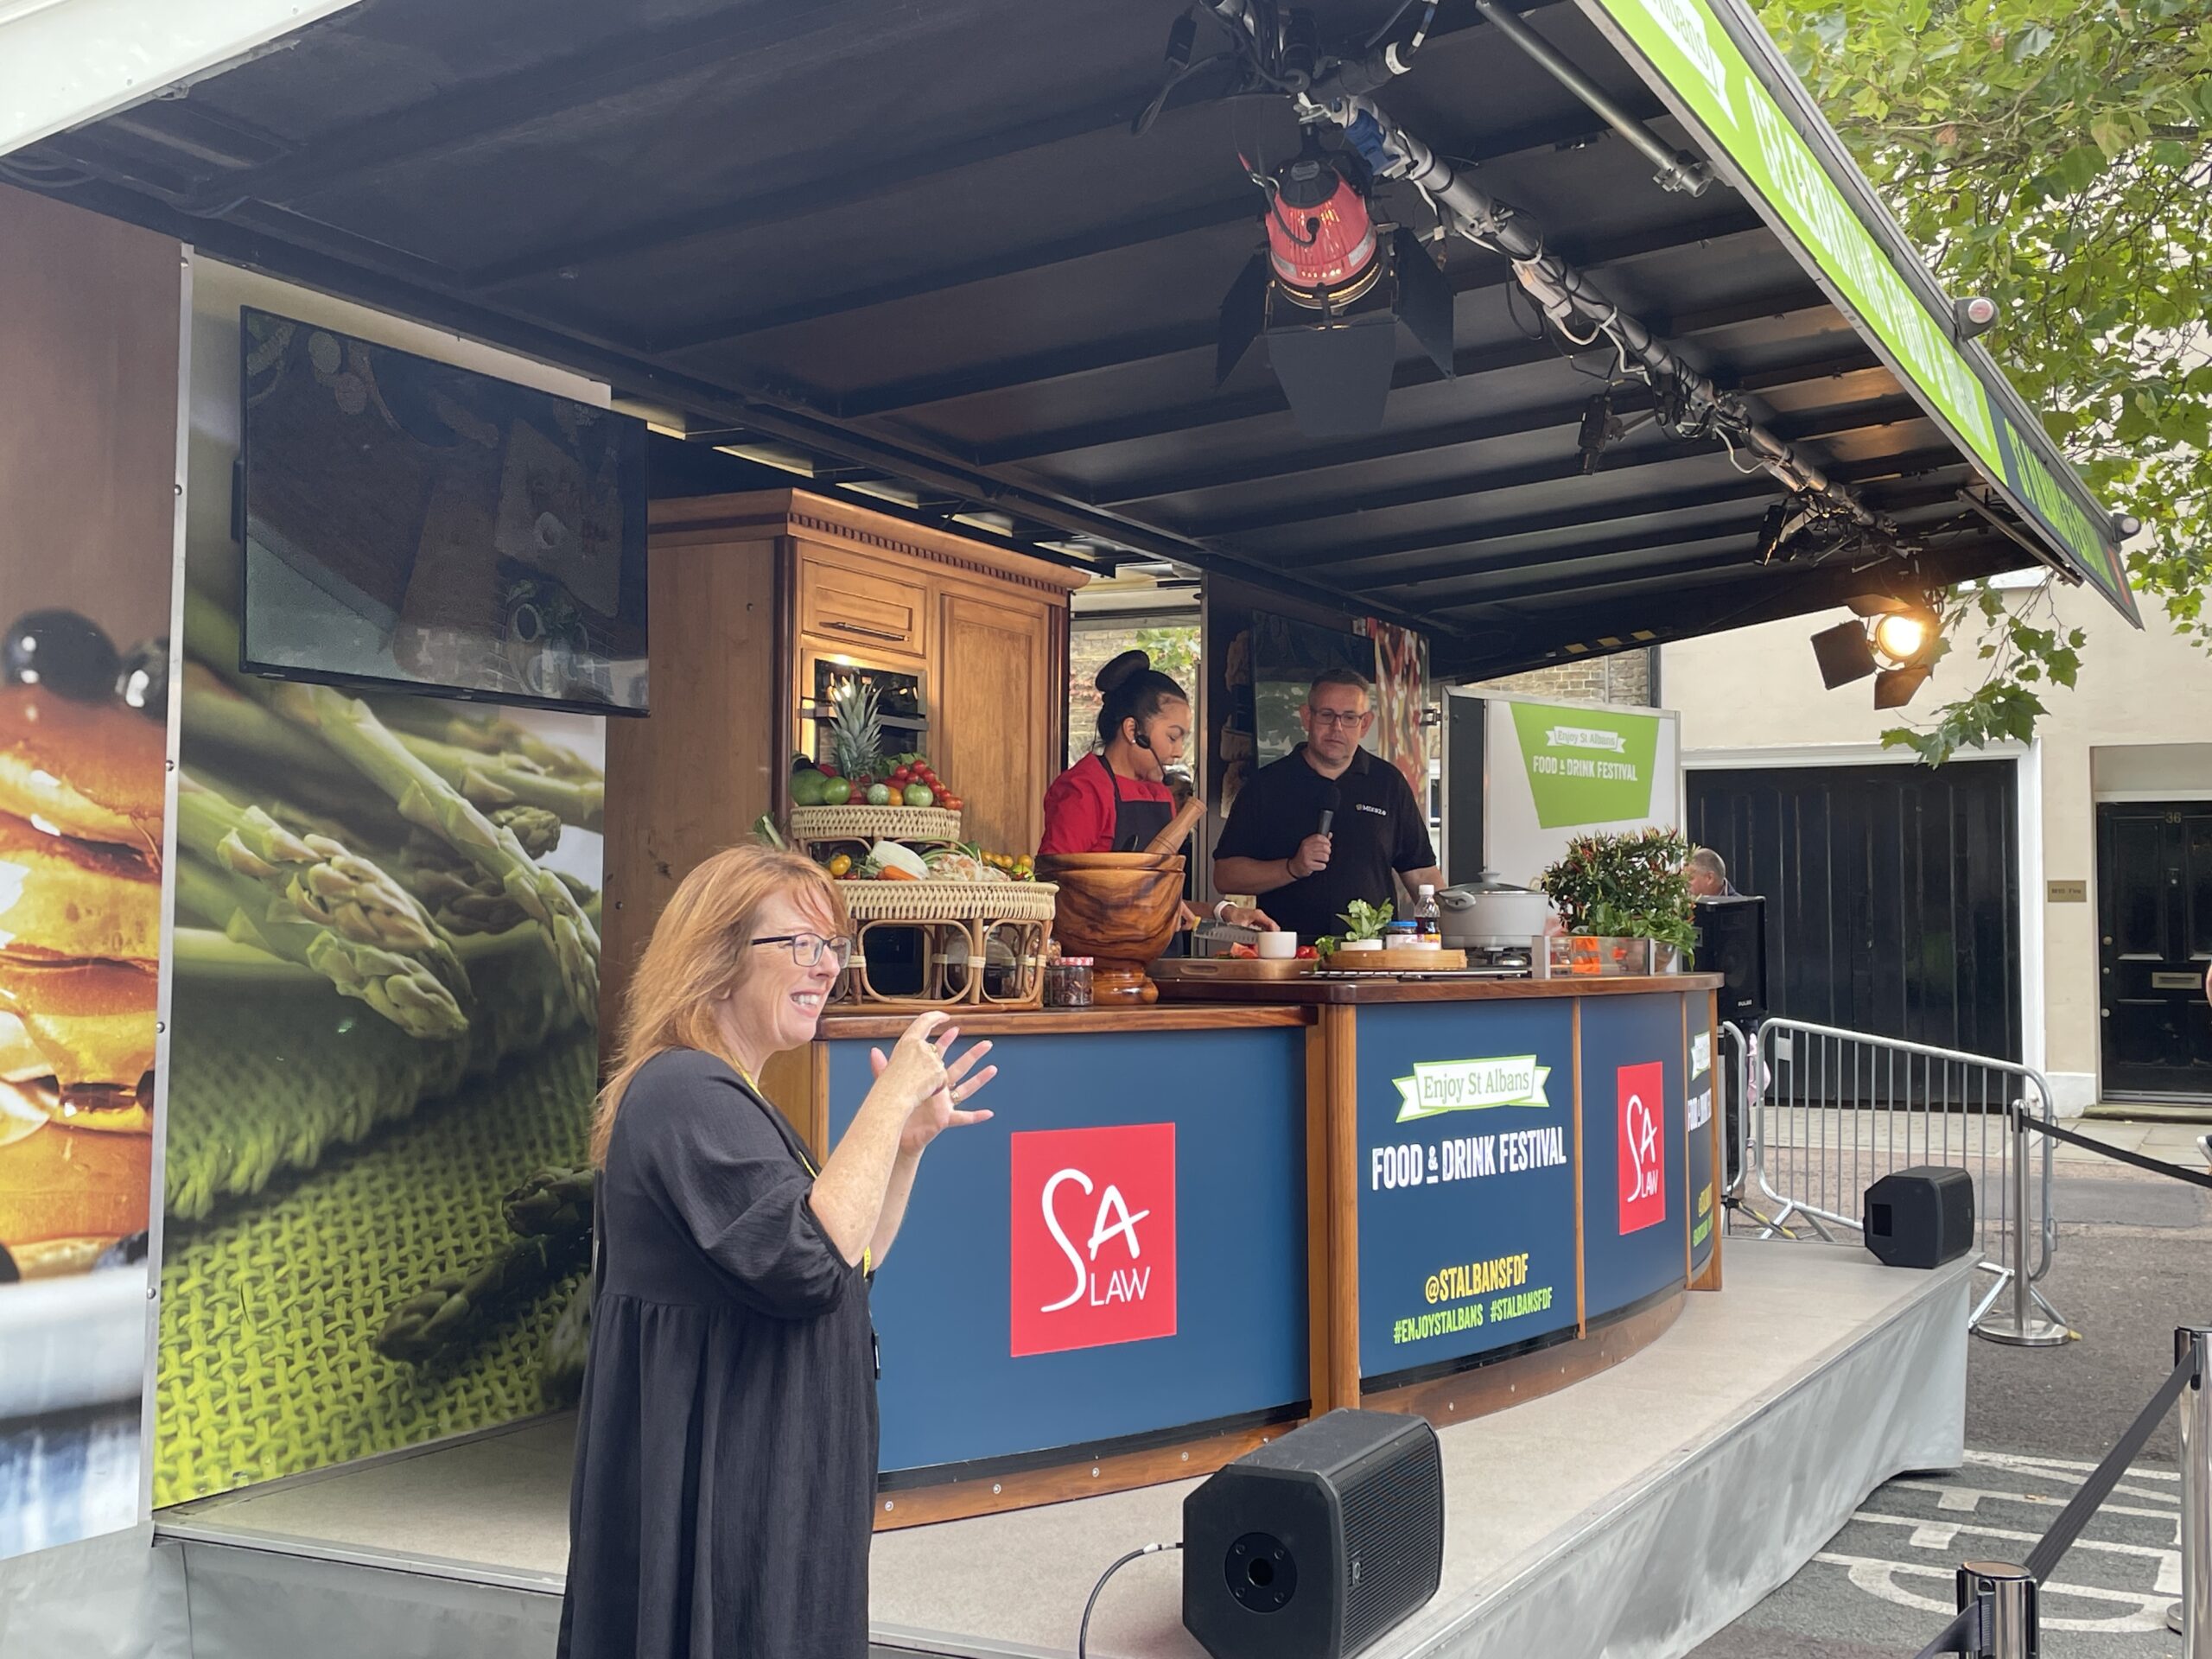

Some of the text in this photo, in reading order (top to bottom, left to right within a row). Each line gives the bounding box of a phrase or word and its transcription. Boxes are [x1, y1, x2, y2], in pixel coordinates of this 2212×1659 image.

[1557, 729, 1616, 747] Enjoy St Albans
[1533, 755, 1558, 774] FOOD
[1567, 759, 1595, 778] DRINK
[1598, 761, 1638, 782] FESTIVAL
[2165, 811, 2182, 823] 36
[1423, 1068, 1530, 1105] Enjoy St Albans
[1372, 1126, 1567, 1191] FOOD & DRINK FESTIVAL
[1626, 1094, 1658, 1203] SA
[1641, 1168, 1659, 1198] LAW
[1040, 1168, 1150, 1313] SA
[1090, 1266, 1151, 1306] LAW
[1426, 1253, 1529, 1305] @STALBANSFDF
[1394, 1287, 1554, 1344] #ENJOYSTALBANS #STALBANSFDF
